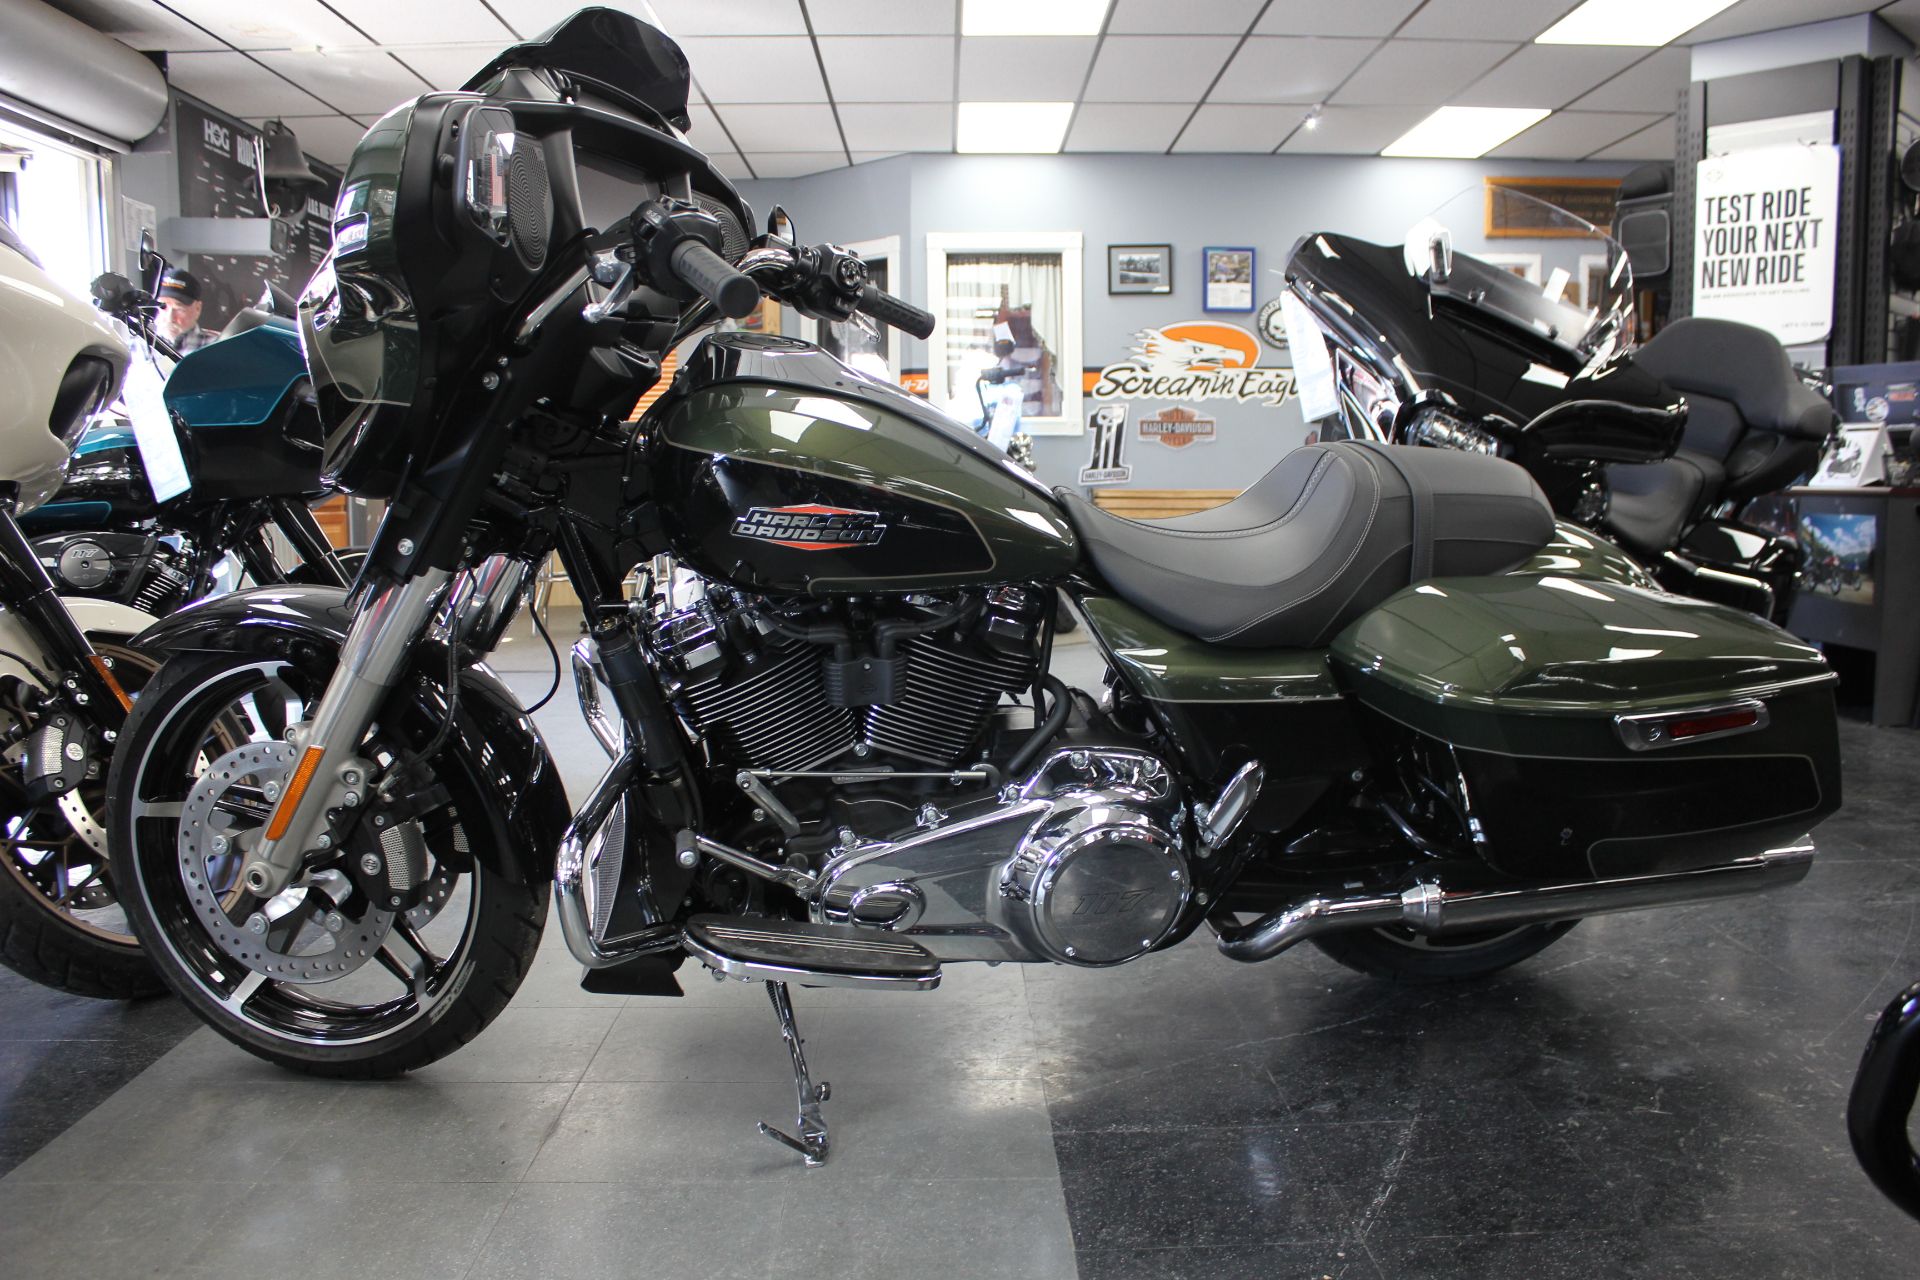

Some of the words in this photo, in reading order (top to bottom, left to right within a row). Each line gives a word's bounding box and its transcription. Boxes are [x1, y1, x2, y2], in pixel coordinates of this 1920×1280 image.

[1704, 193, 1755, 225] TEST
[1761, 187, 1811, 220] RIDE
[1703, 226, 1757, 257] YOUR
[1764, 218, 1823, 252] NEXT
[1702, 258, 1750, 289] NEW
[1755, 253, 1805, 285] RIDE
[1237, 371, 1299, 406] Eagl
[1143, 422, 1213, 433] HARLEY-DAVIDSON
[737, 523, 880, 541] DAVIDSON
[71, 549, 99, 559] 117
[1073, 887, 1155, 915] 117
